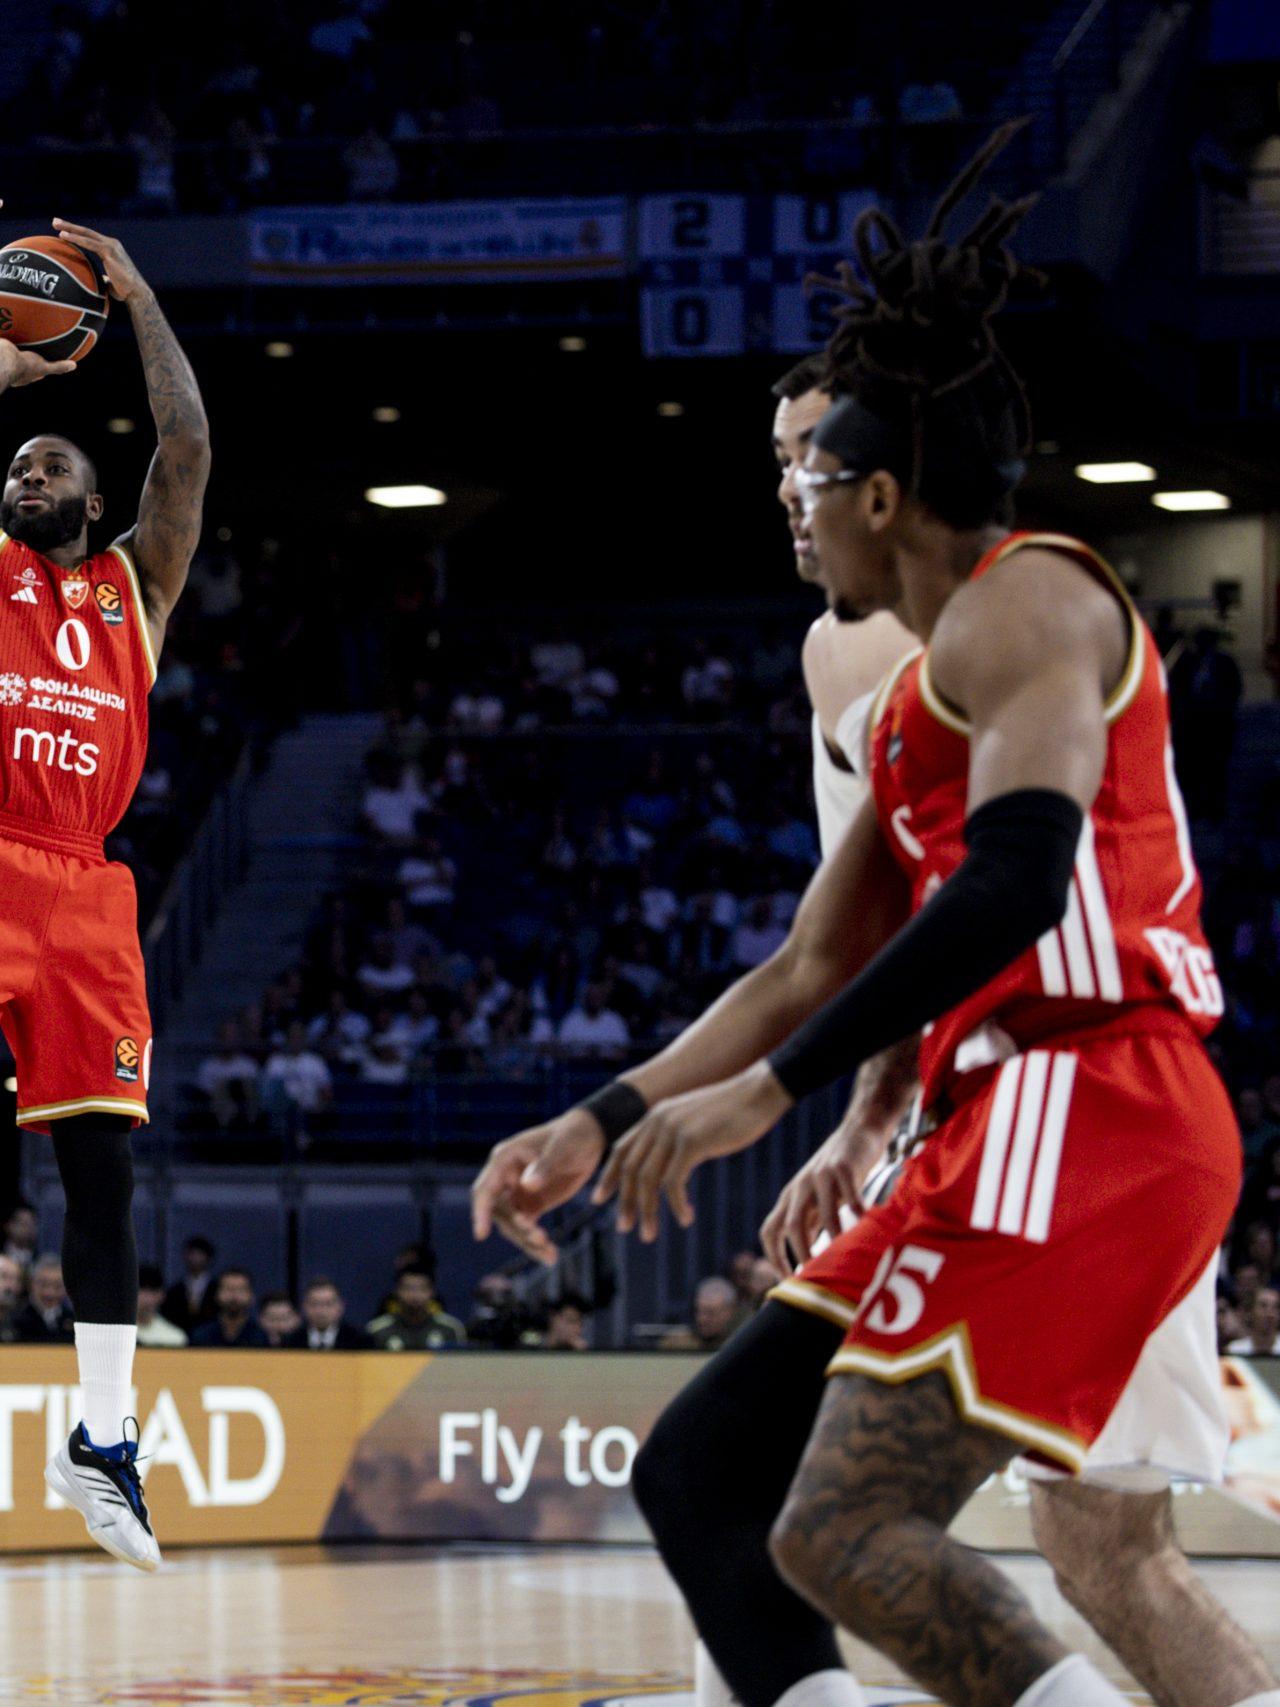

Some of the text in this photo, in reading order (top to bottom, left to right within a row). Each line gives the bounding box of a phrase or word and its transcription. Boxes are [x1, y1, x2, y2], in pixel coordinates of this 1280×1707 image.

[675, 200, 710, 247] 2
[676, 299, 708, 346] 0
[55, 618, 91, 671] 0
[13, 726, 100, 777] mts
[860, 1243, 946, 1335] 5
[439, 1408, 639, 1503] Fly to
